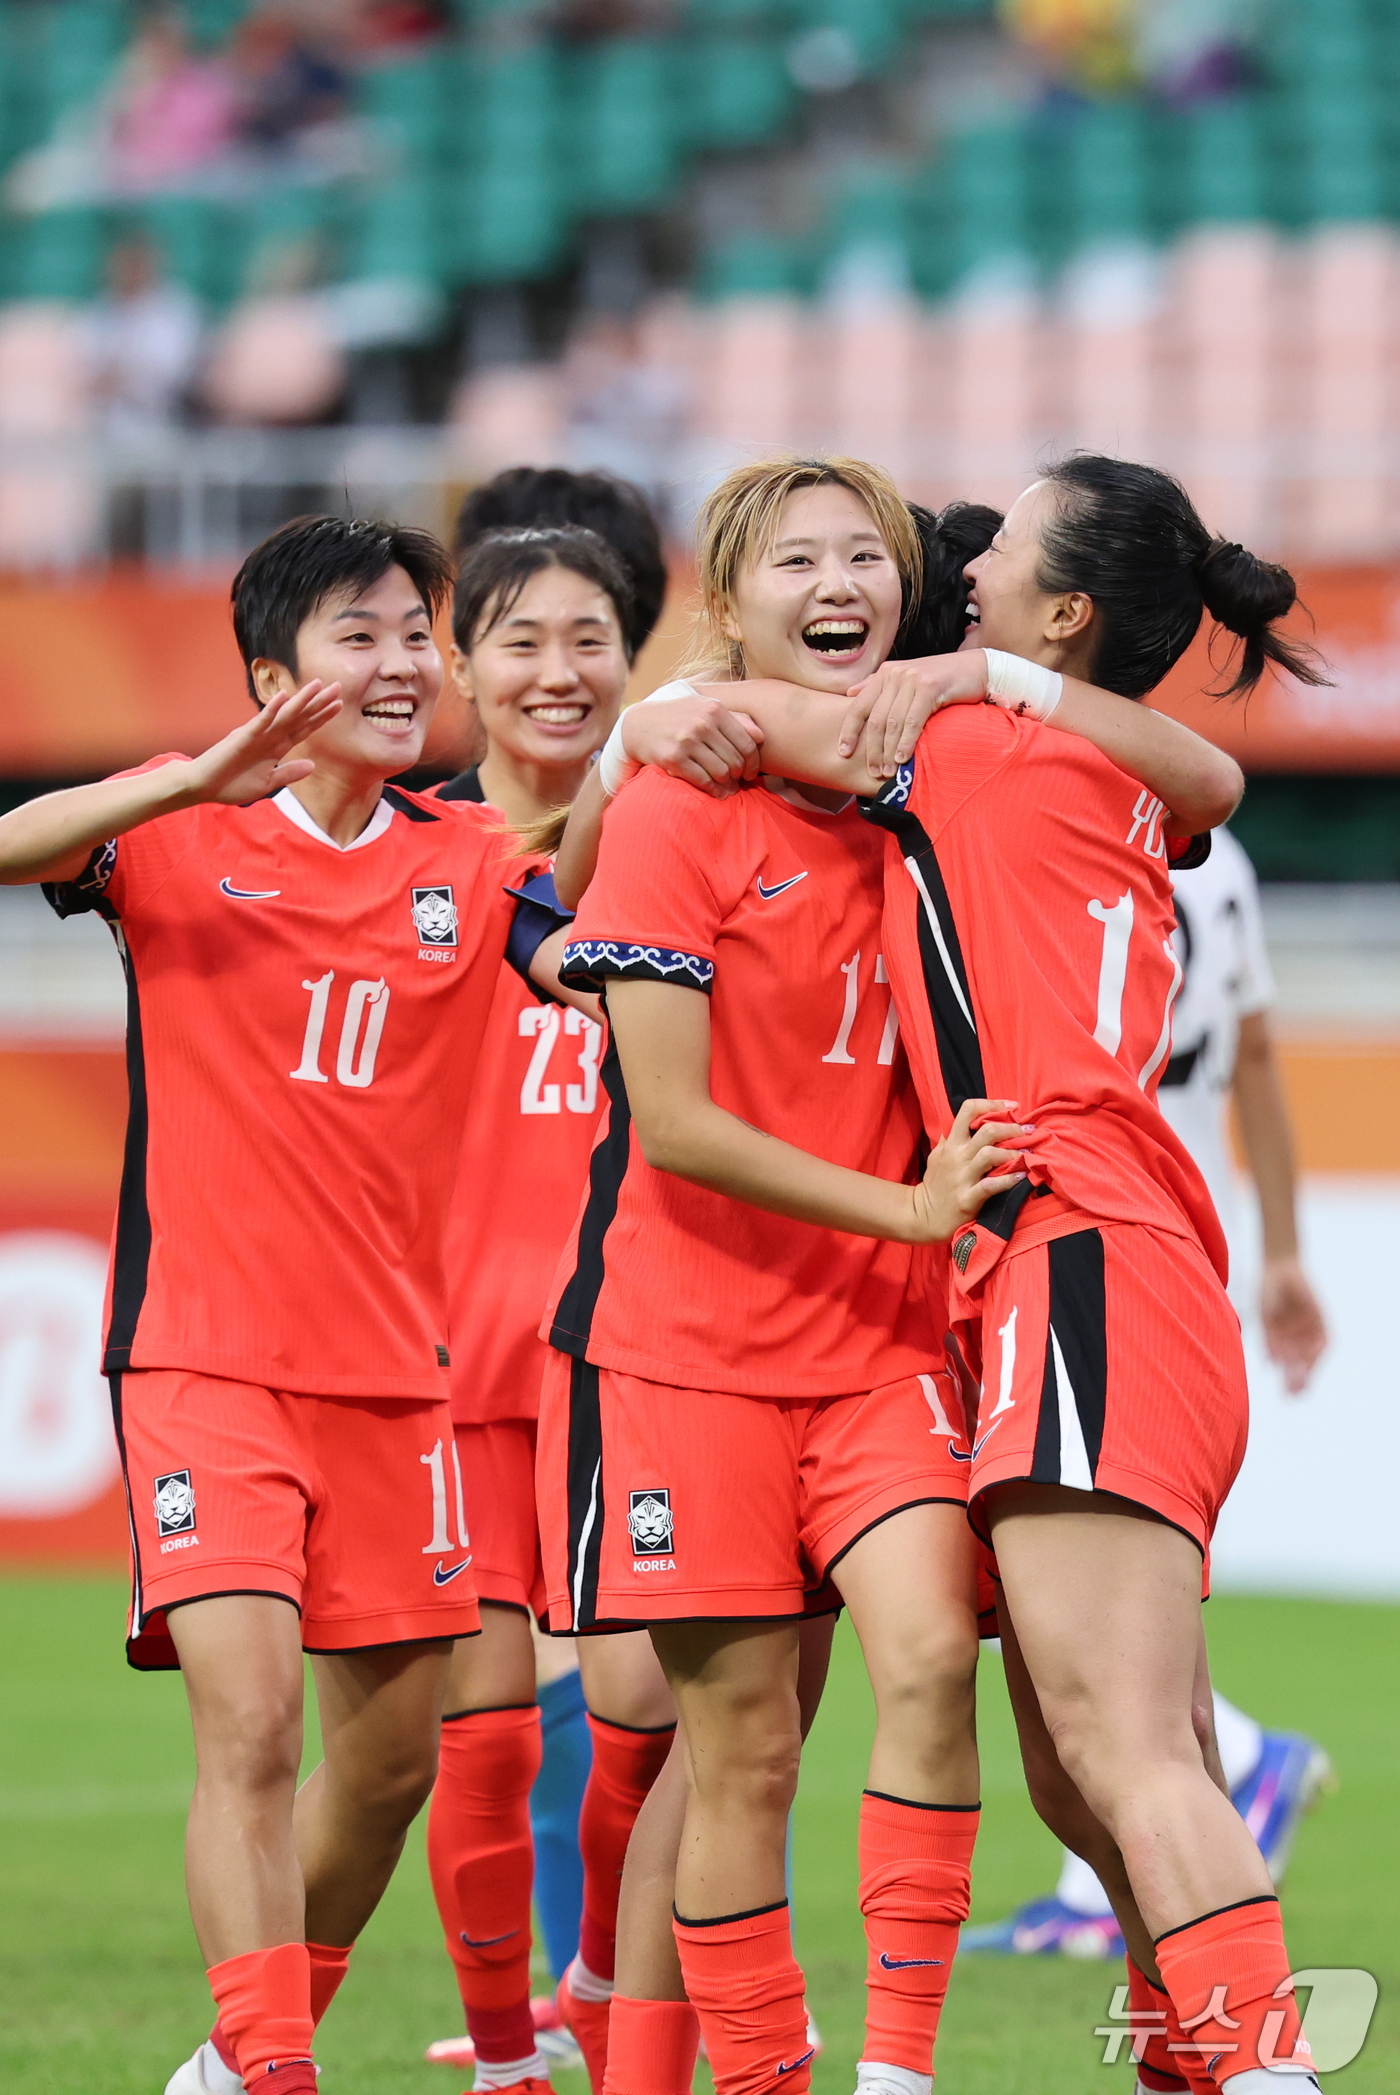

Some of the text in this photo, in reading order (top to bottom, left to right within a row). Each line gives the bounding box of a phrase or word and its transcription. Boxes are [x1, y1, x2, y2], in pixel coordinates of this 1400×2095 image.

[1125, 789, 1172, 863] YU
[417, 948, 457, 963] KOREA
[289, 968, 391, 1089] 10
[518, 1003, 603, 1115] 23
[160, 1535, 199, 1555] KOREA
[633, 1559, 677, 1572] KOREA
